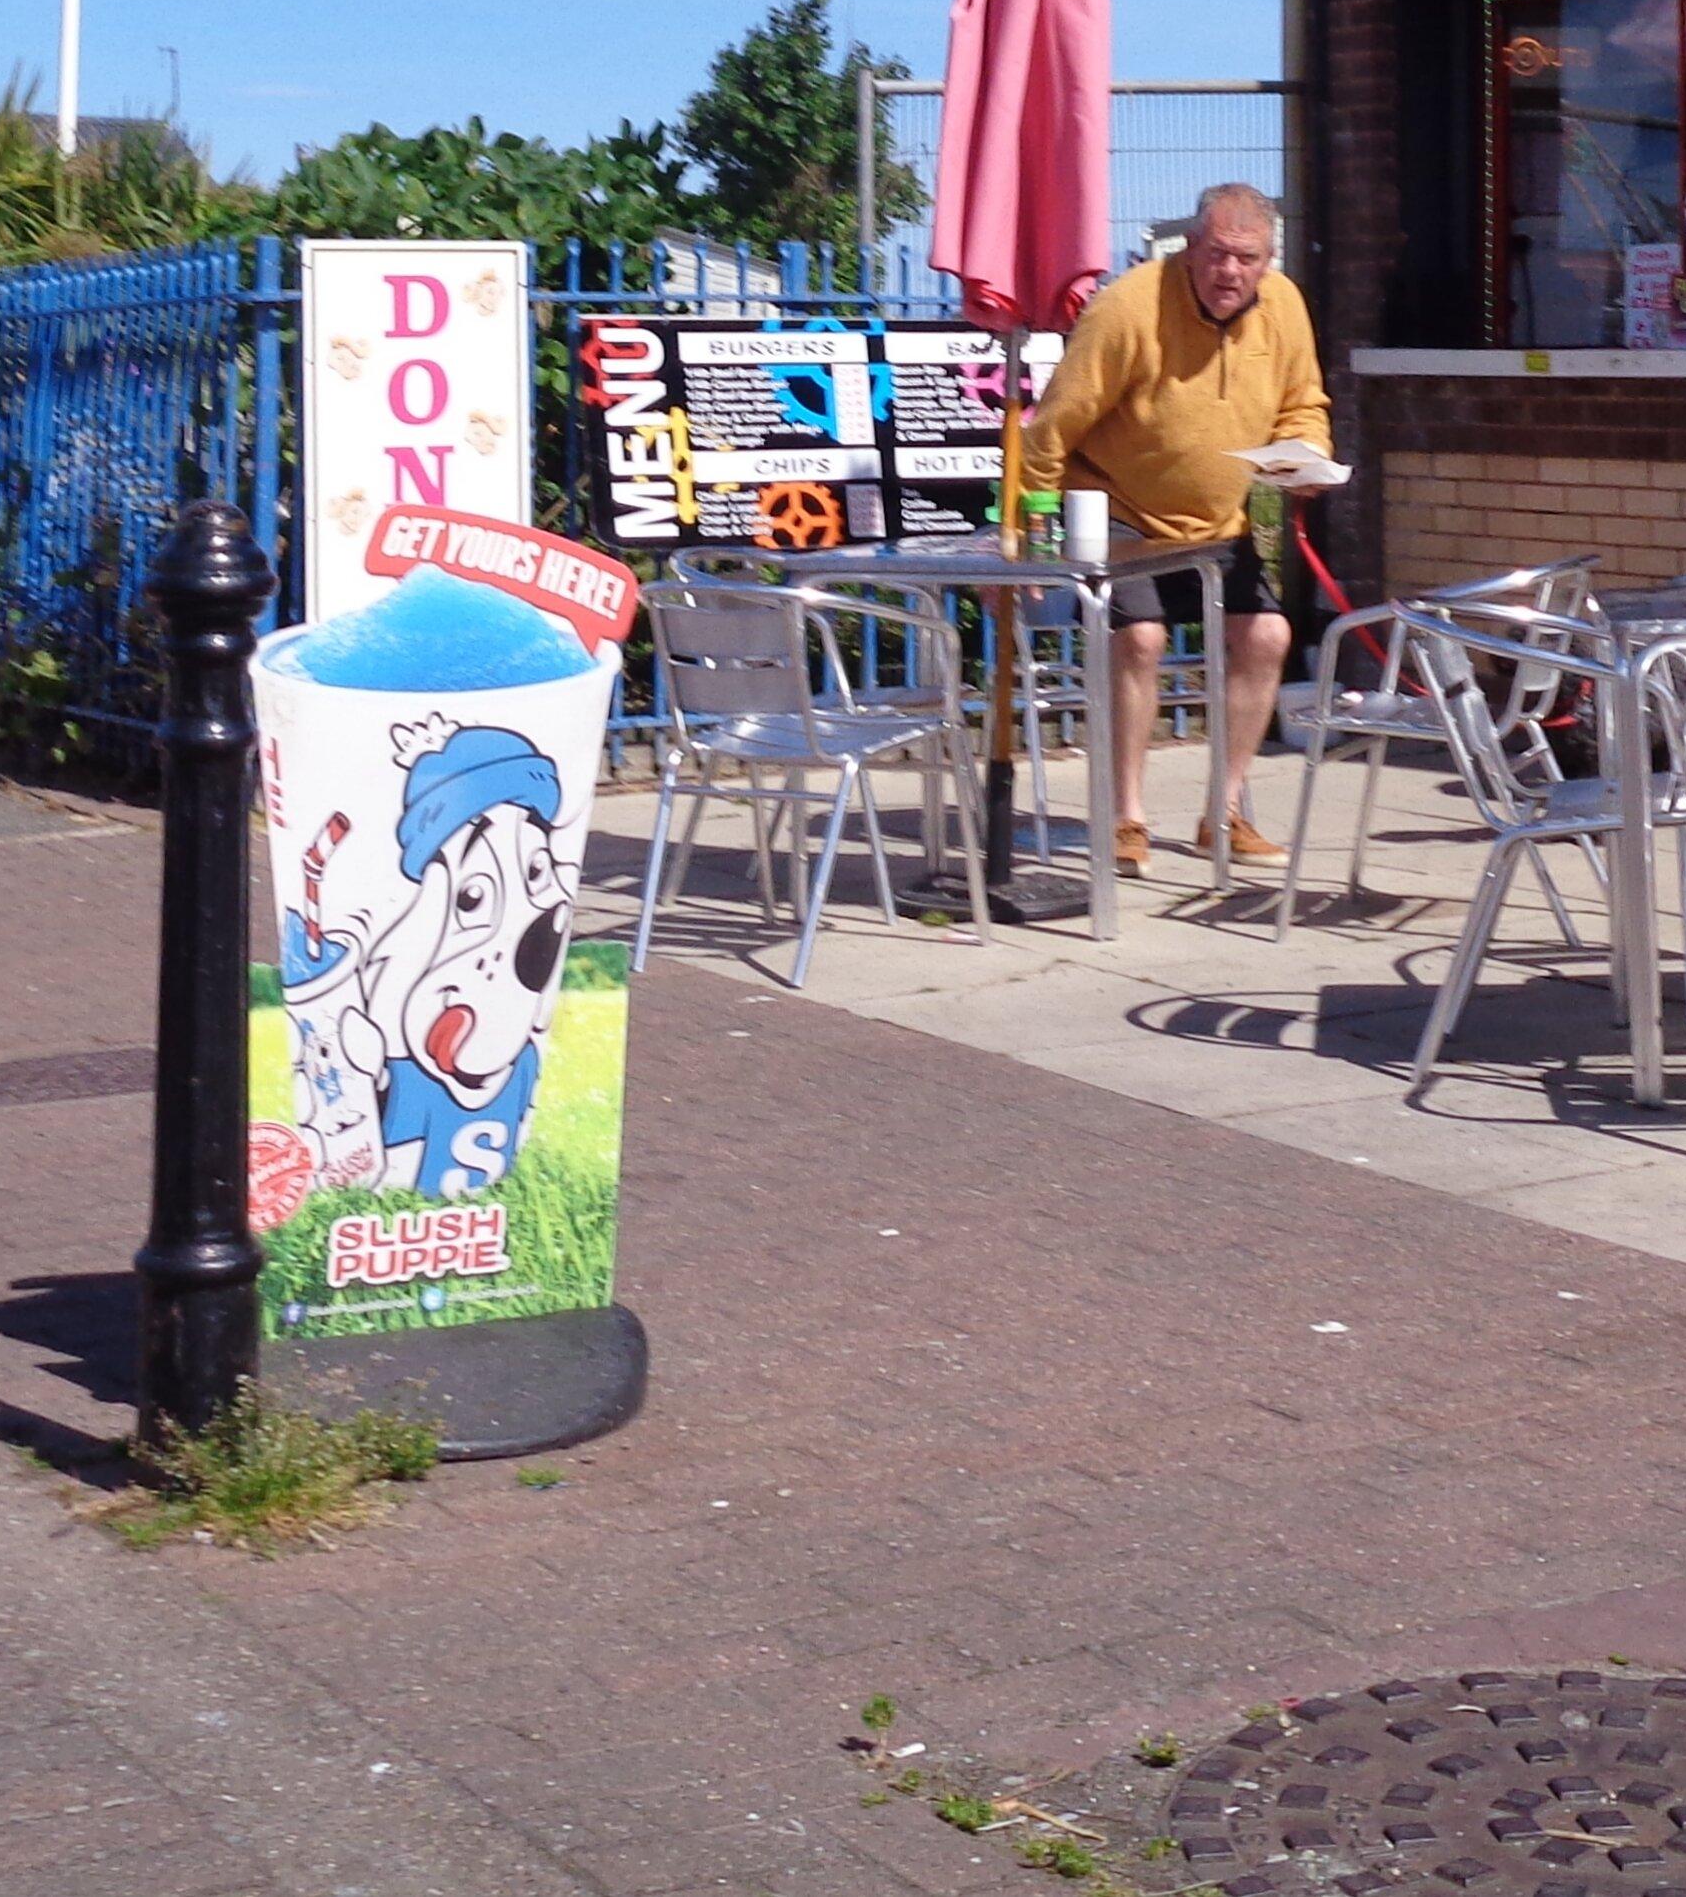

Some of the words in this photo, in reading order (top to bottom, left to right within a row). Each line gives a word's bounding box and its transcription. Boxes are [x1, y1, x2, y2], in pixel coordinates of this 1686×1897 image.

[708, 340, 837, 357] BURGERS
[598, 326, 680, 539] MENU
[754, 457, 831, 474] CHIPS
[914, 455, 962, 472] HOT
[382, 516, 444, 559] GET
[445, 524, 539, 584] YOURS
[537, 543, 626, 620] HERE!
[336, 1209, 500, 1250] SLUSH
